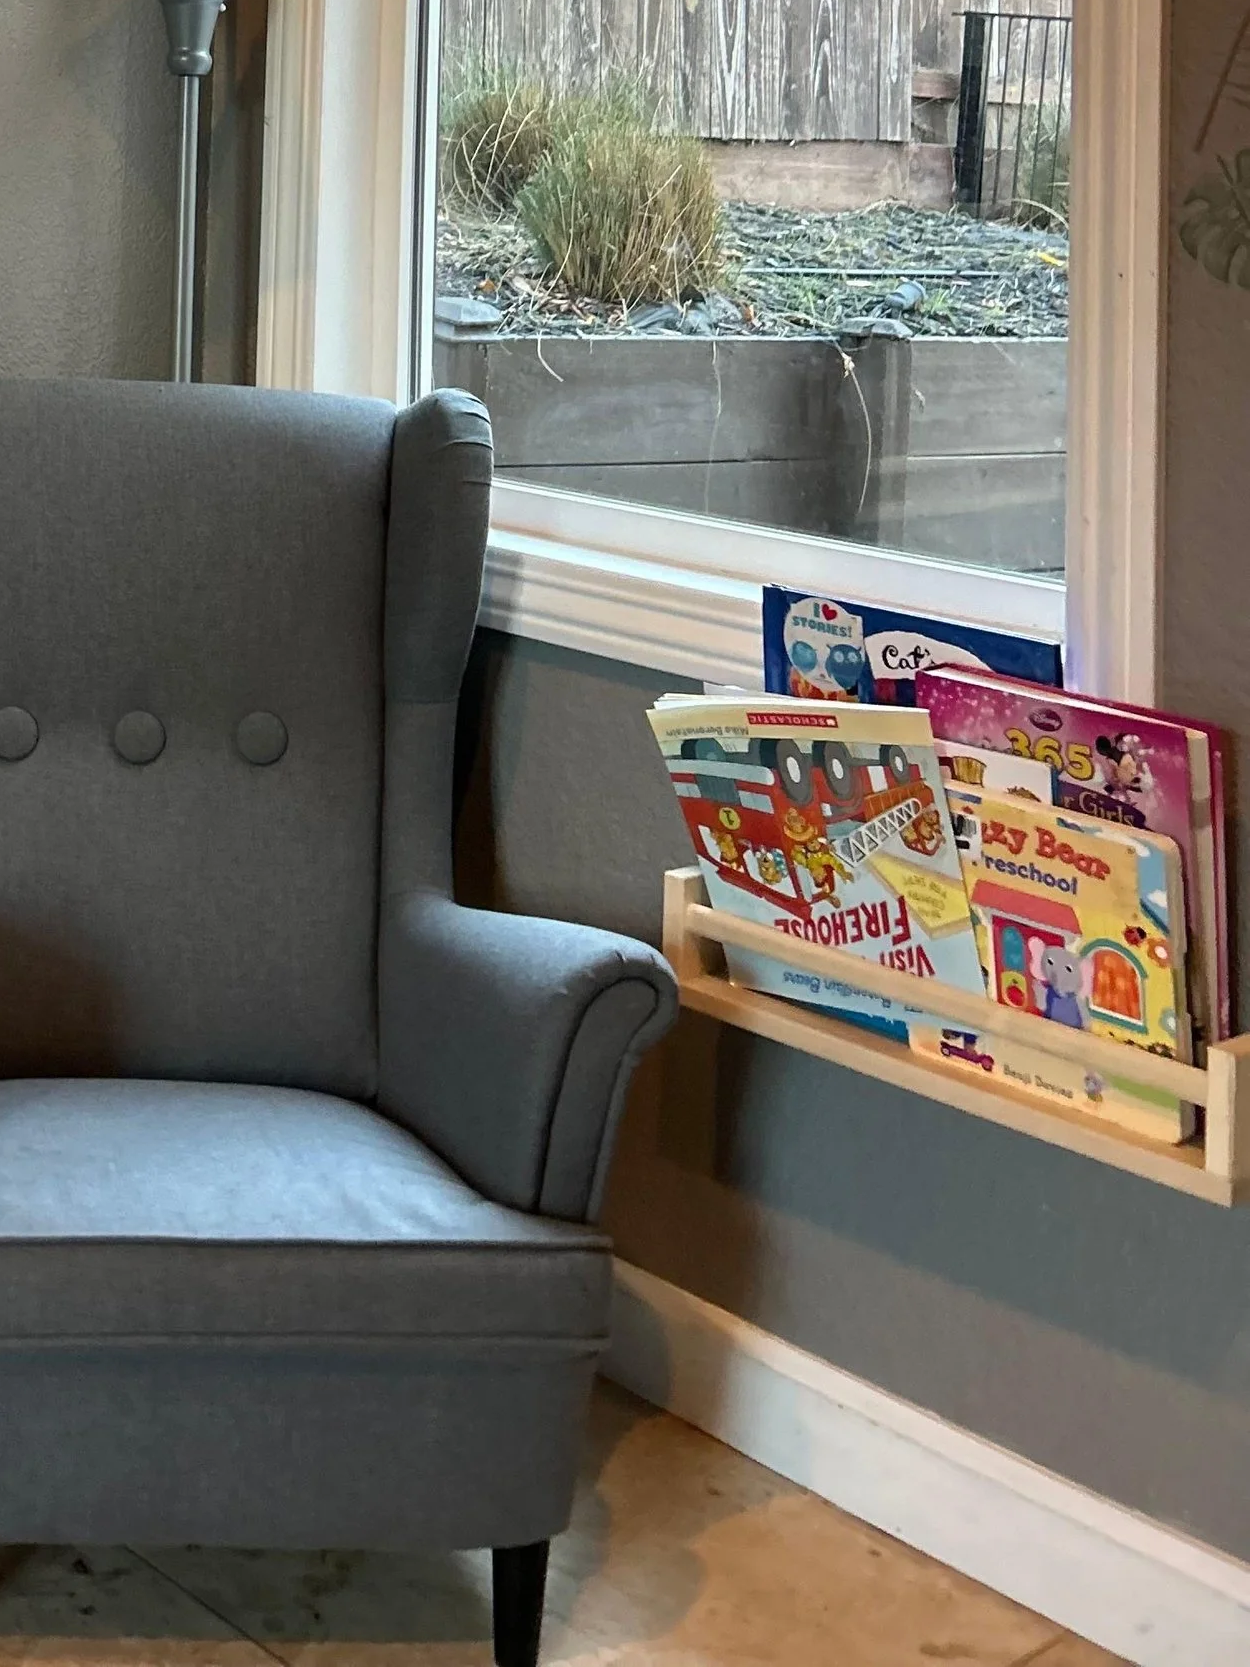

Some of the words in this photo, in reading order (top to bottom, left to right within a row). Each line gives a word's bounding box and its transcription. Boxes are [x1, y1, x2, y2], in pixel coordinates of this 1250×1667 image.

[812, 602, 820, 618] I
[792, 615, 852, 638] STORIES!
[725, 726, 749, 735] Mike
[750, 716, 827, 726] SCHOLASTIC
[1004, 727, 1094, 781] 365
[1034, 825, 1111, 880] Bear
[981, 851, 1078, 895] reschool
[783, 971, 820, 993] Bears
